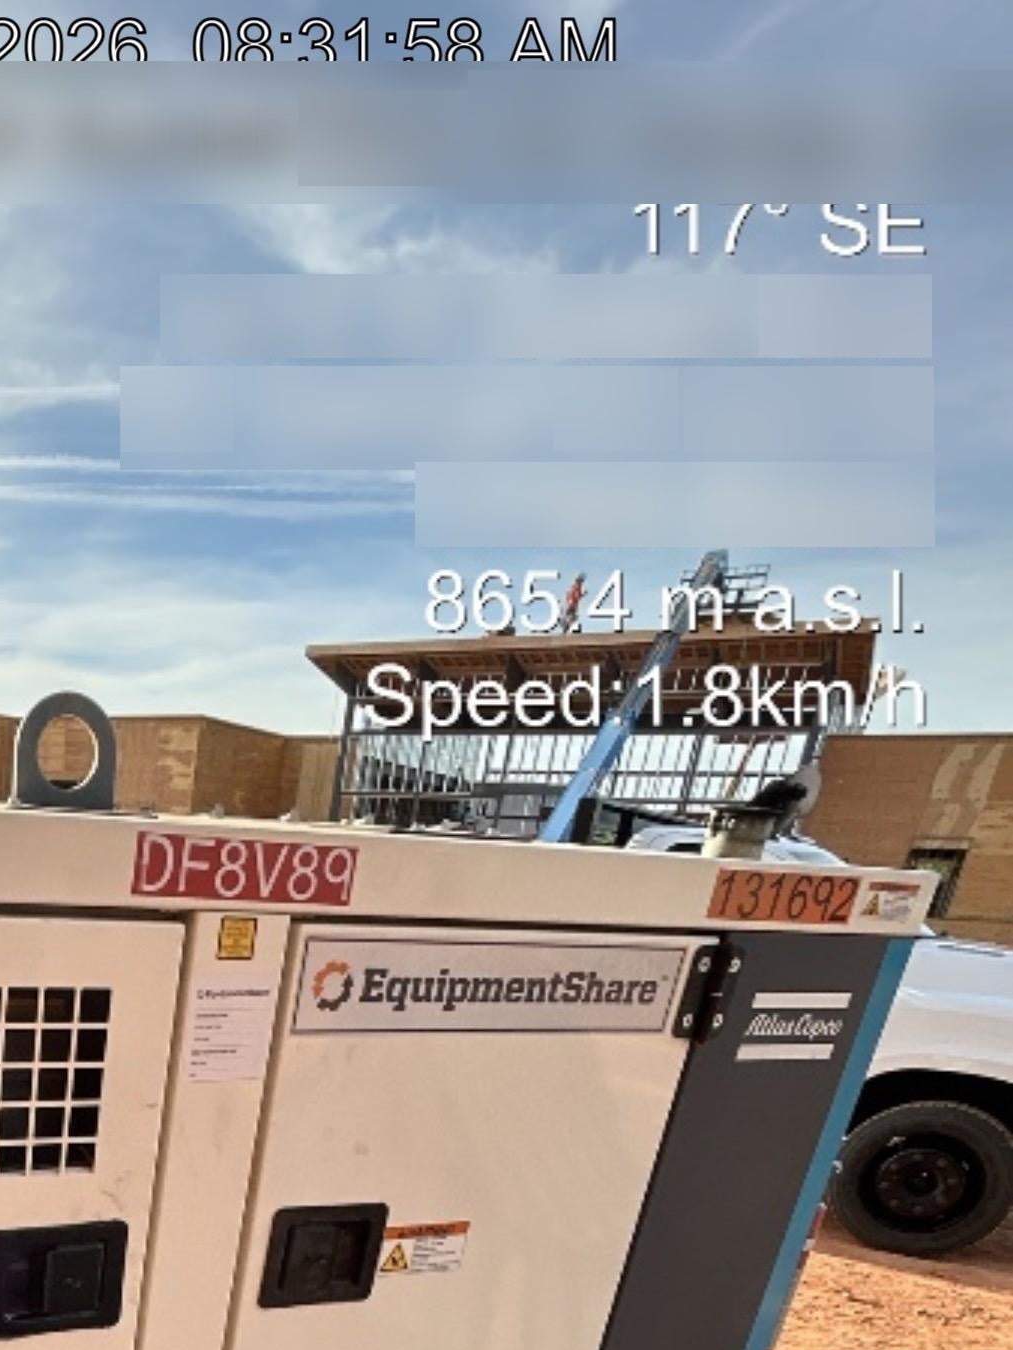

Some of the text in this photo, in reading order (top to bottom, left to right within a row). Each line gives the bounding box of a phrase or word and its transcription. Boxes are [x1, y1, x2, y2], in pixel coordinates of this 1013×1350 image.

[140, 834, 354, 901] DF8V89
[718, 870, 859, 923] 131692
[359, 968, 658, 1012] EquipmentShare
